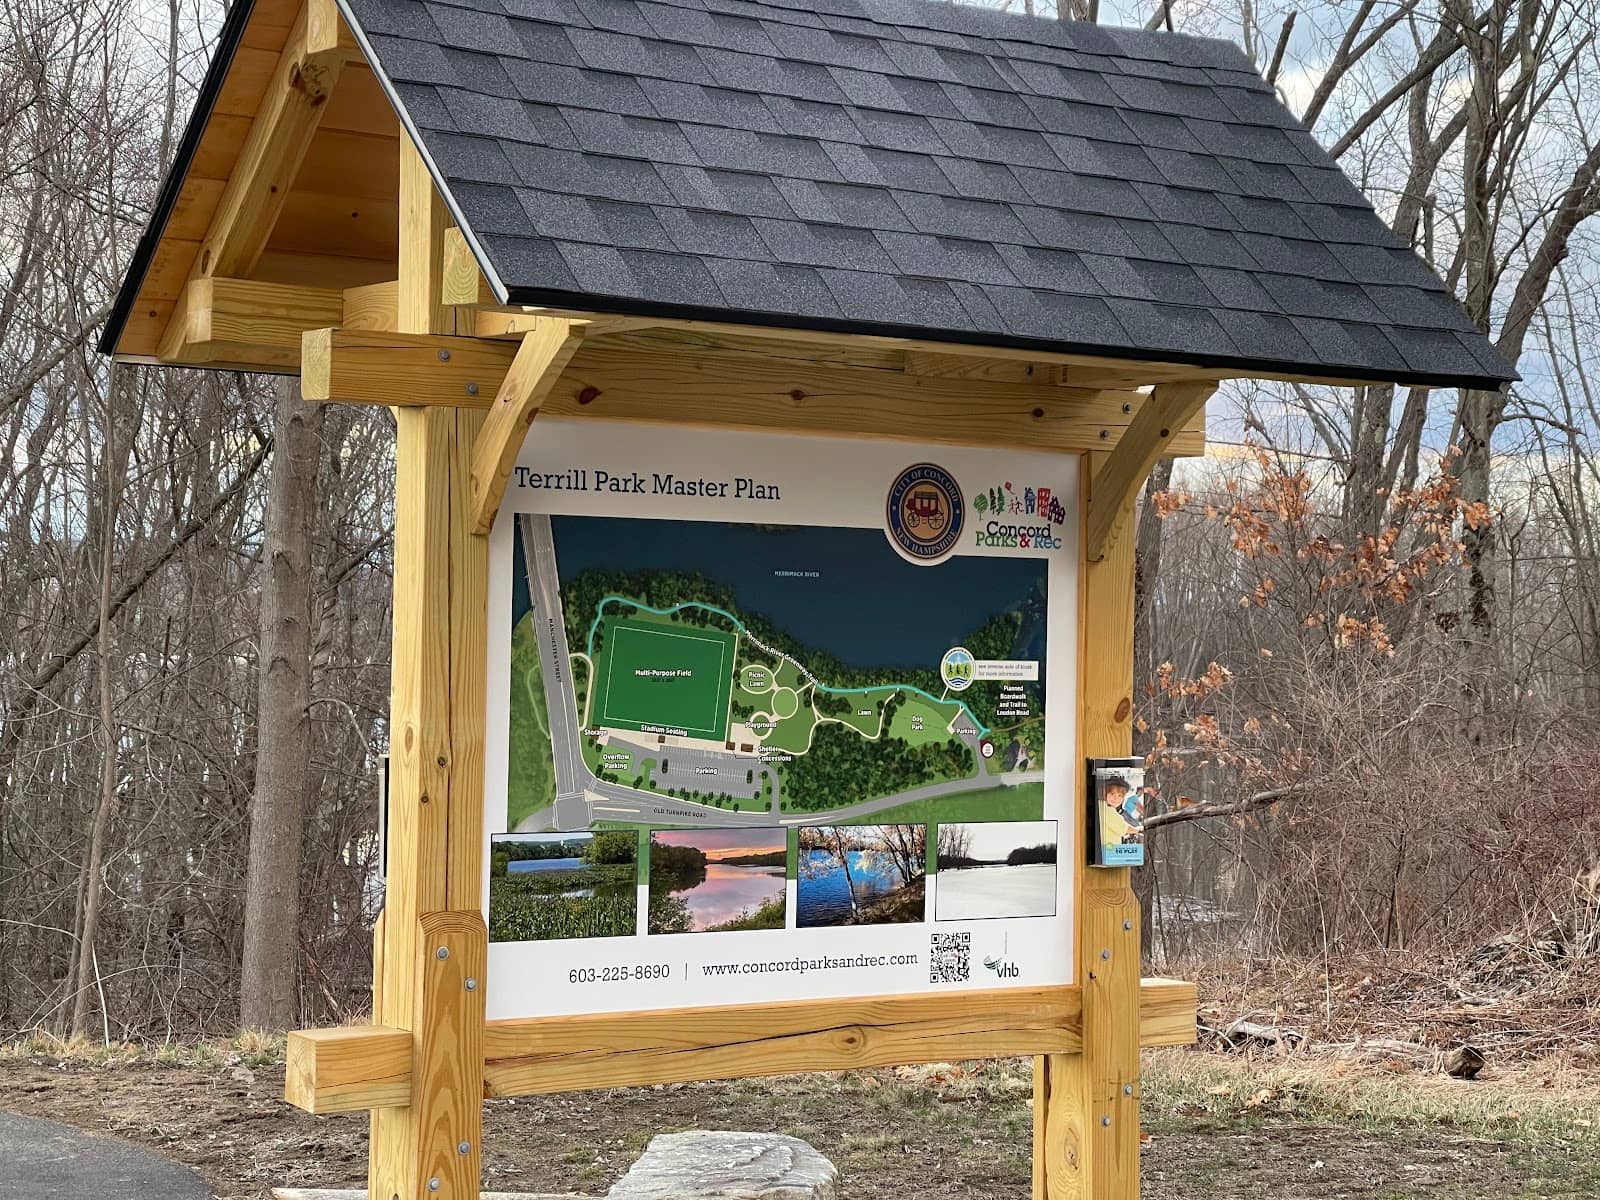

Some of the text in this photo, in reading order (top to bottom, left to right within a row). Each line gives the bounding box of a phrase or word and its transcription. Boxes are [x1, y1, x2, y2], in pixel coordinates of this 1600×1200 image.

[514, 466, 781, 500] Terrill Park Master Plan
[894, 469, 961, 502] CITY OF CONCORD
[986, 520, 1051, 539] Concord
[895, 527, 958, 555] NEW HAMPSHIRE
[975, 531, 1062, 549] Parks & Rec
[549, 618, 562, 683] MANCHESTER STREET
[745, 630, 769, 651] Merrimack
[770, 647, 785, 657] River
[635, 669, 692, 678] Multi-Purpose Field
[748, 671, 765, 679] Picnic
[584, 729, 608, 737] Storage
[641, 724, 688, 736] Stadium Seating
[695, 766, 718, 775] Parking
[666, 809, 691, 817] TURNPIKE
[569, 952, 918, 983] 603-225-8690 www.concordparksandrec.com
[996, 961, 1019, 978] vhb
